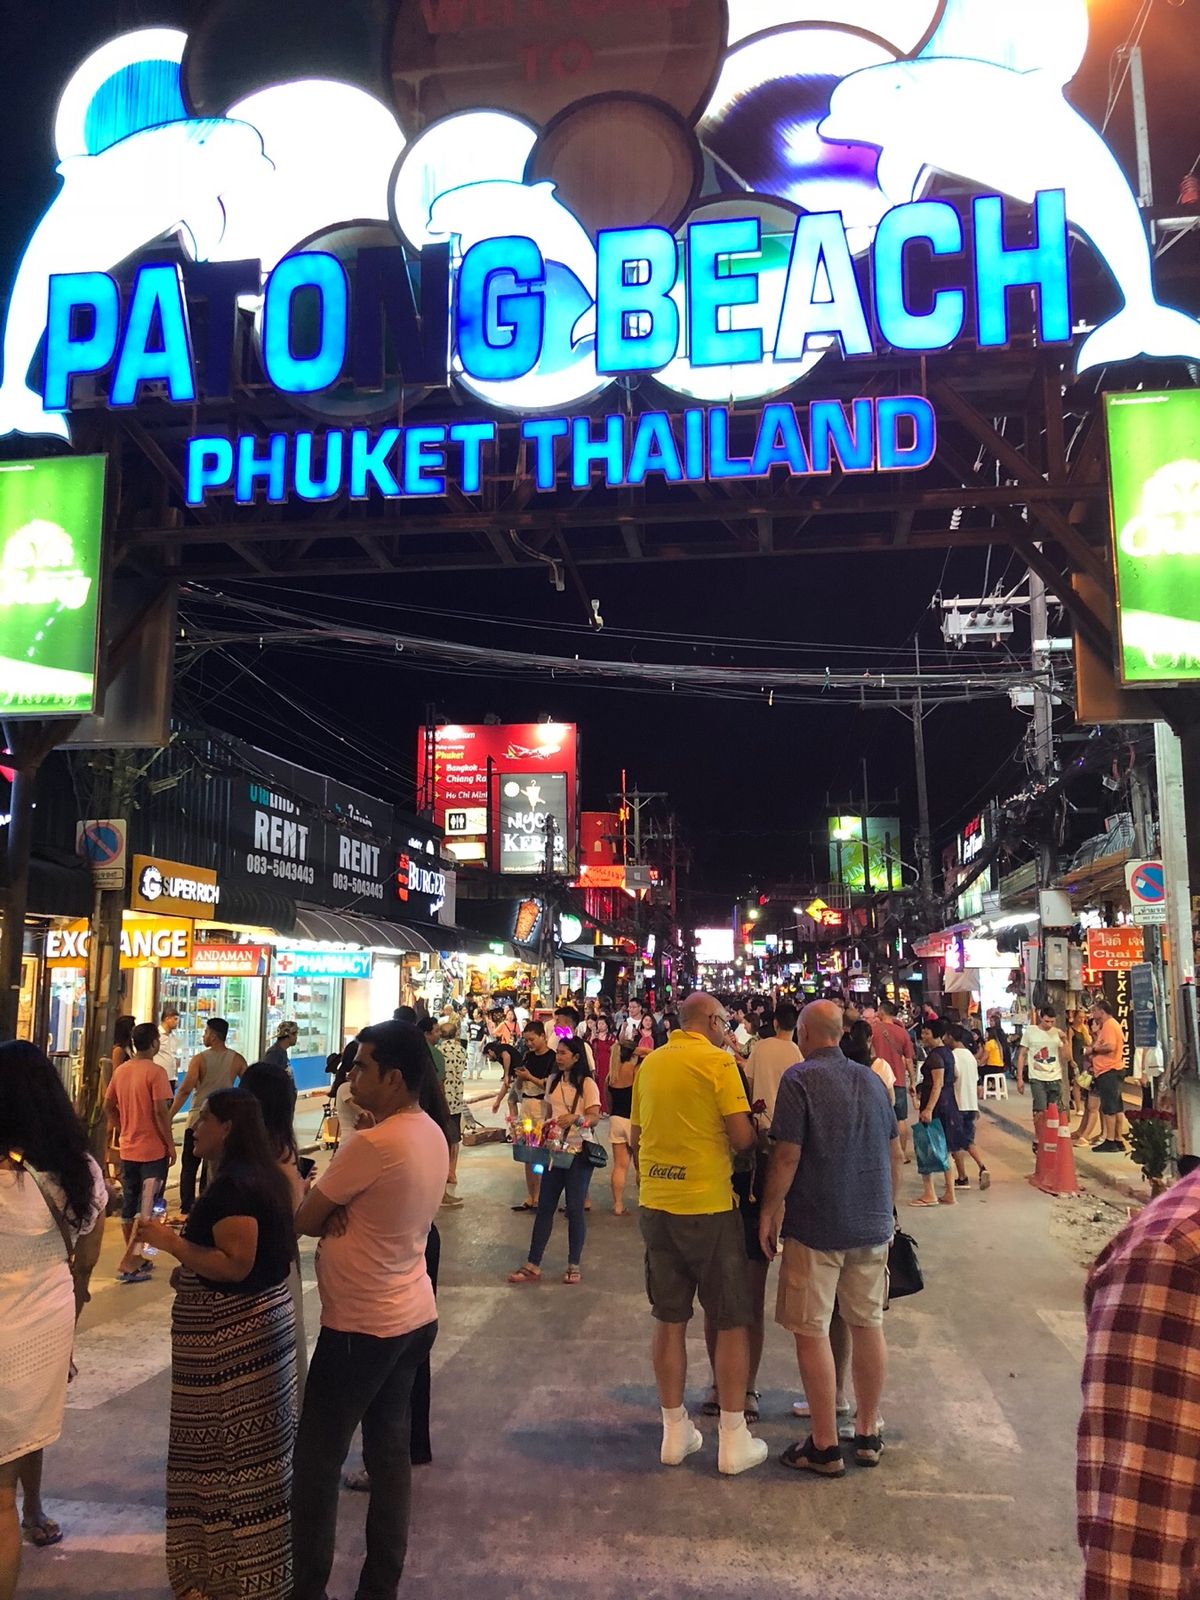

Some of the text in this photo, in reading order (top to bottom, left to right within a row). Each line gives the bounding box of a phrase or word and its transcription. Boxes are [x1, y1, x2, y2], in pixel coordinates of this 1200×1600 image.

[42, 188, 1071, 412] PATONG BEACH
[185, 396, 937, 508] PHUKET THAILAND
[435, 751, 464, 760] Phuket
[446, 764, 478, 773] Bangkok
[446, 775, 474, 784] Chiang
[458, 791, 470, 799] Chi
[254, 809, 309, 861] RENT
[247, 854, 314, 885] 083-5043443
[339, 835, 380, 877] RENT
[333, 872, 384, 899] 083-5043443
[408, 861, 446, 897] BURGER
[46, 929, 188, 958] EXCANGE
[196, 950, 253, 961] ANDAMAN
[1093, 949, 1130, 958] Chai
[1116, 969, 1130, 1069] EXCHANGE
